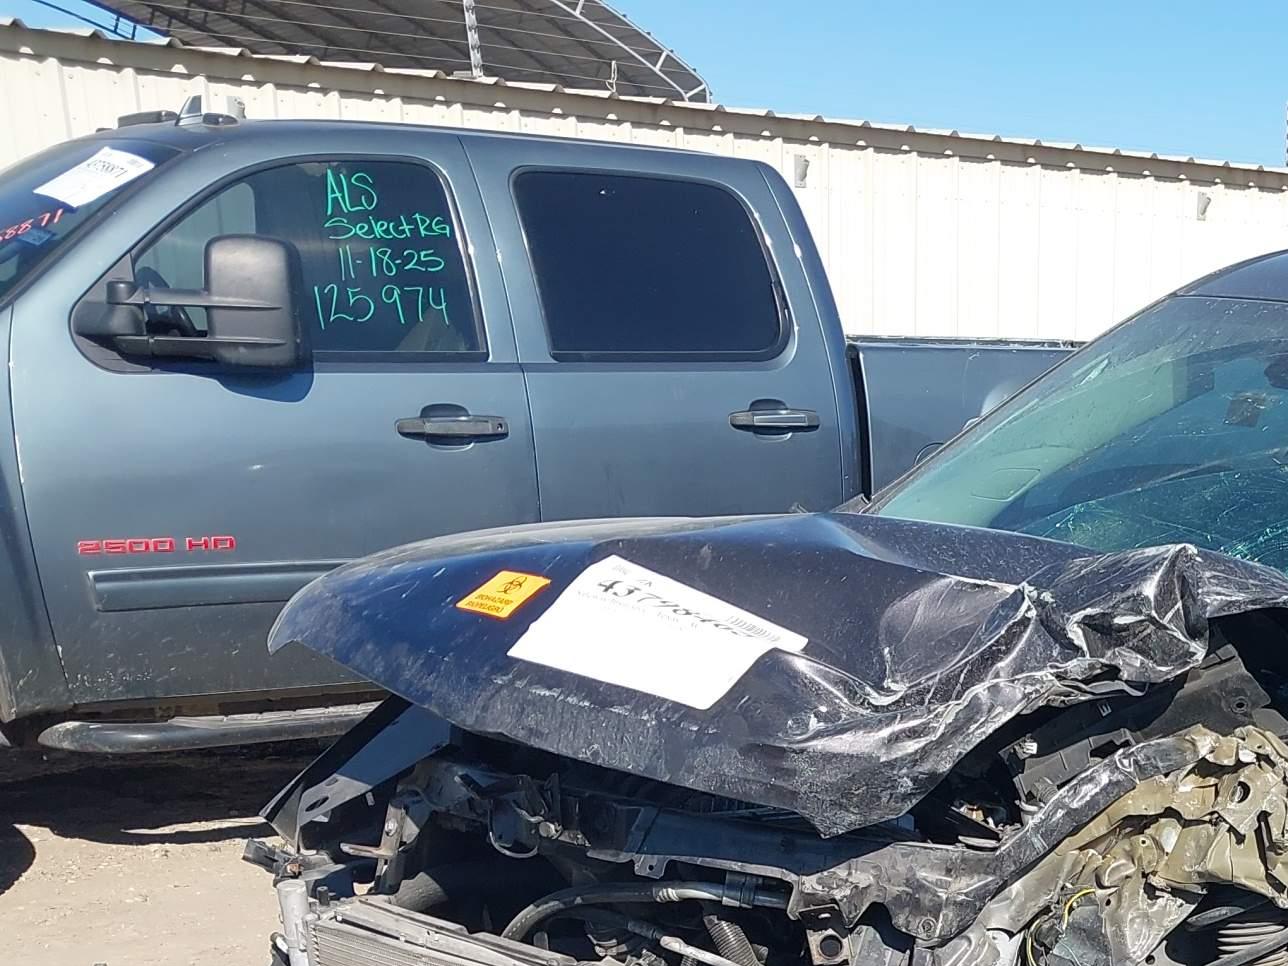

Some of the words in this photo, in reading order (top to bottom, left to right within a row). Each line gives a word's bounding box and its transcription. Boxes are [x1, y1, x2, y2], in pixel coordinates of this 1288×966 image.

[326, 167, 377, 216] ALS
[339, 245, 445, 281] 11-18-25
[314, 283, 449, 330] 125974
[78, 538, 175, 555] 2500
[185, 535, 236, 552] HD
